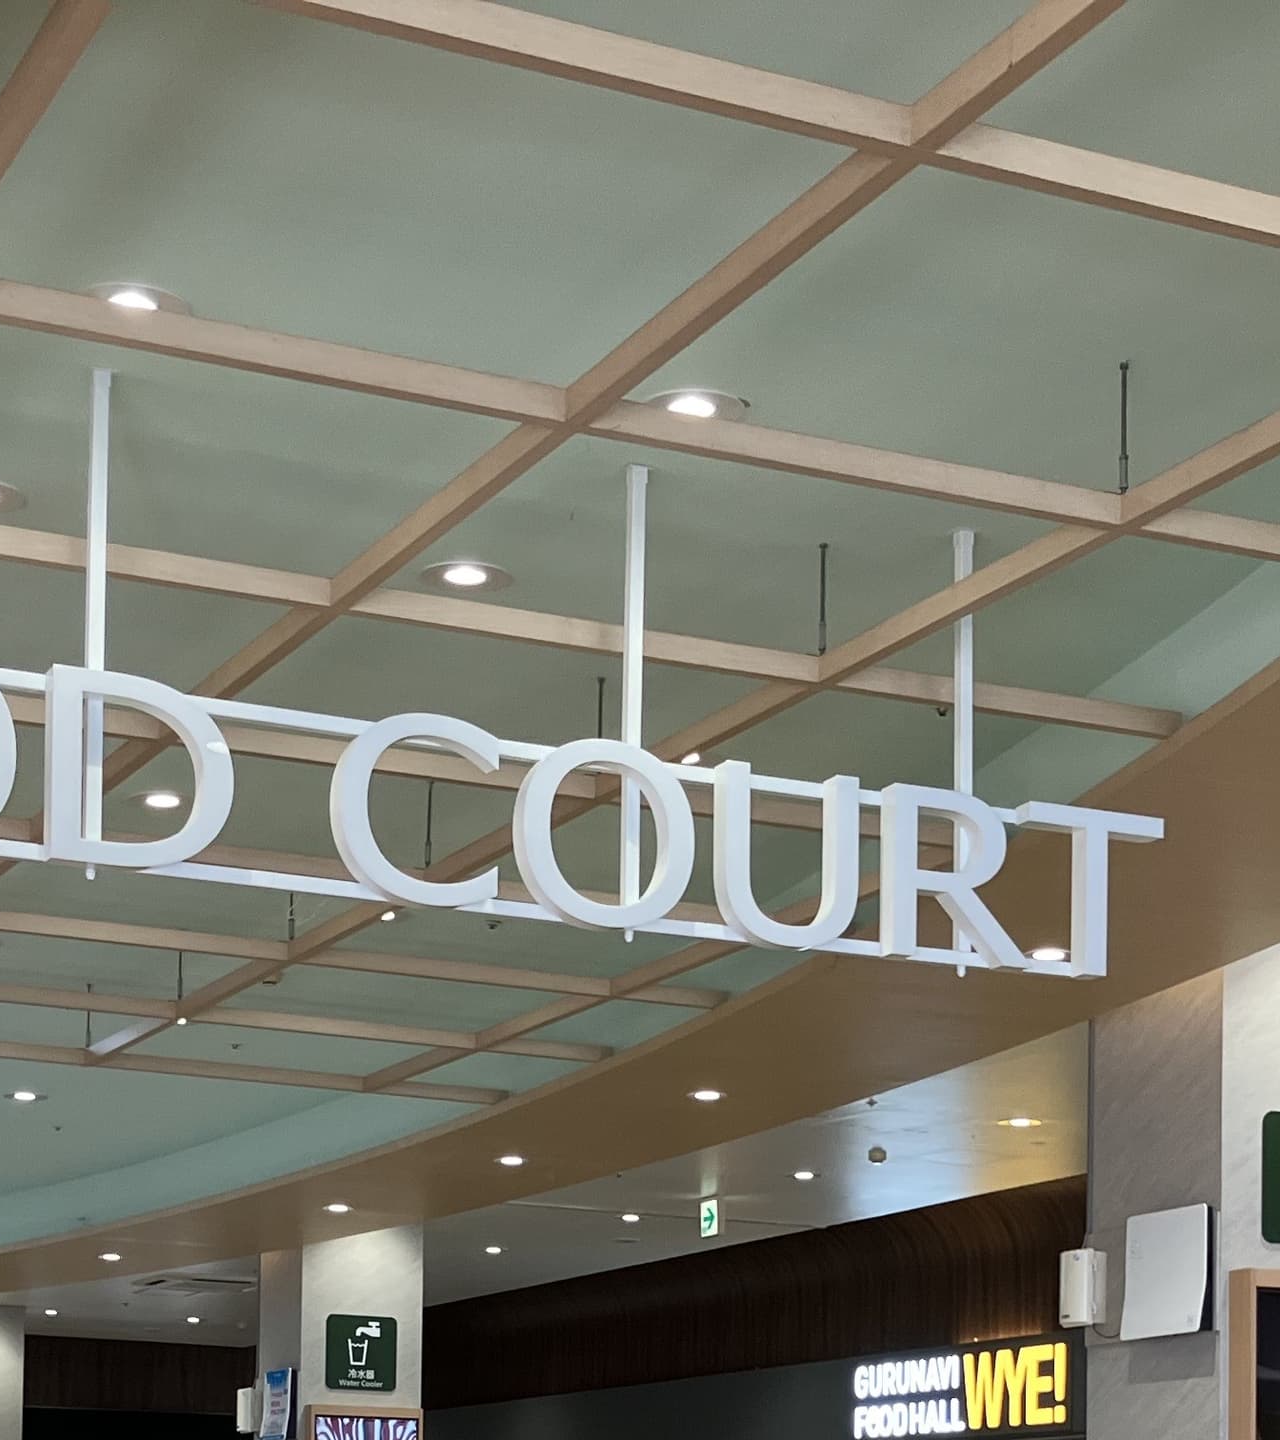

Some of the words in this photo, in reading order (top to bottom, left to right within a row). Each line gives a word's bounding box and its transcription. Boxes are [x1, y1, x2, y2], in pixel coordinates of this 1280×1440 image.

[330, 712, 1164, 978] COURT
[338, 1379, 360, 1387] Water
[361, 1380, 383, 1388] Cooler
[853, 1355, 960, 1400] GURUNAVI
[963, 1343, 1067, 1430] WYE!
[853, 1402, 908, 1440] FOOD
[909, 1398, 966, 1435] HALL
